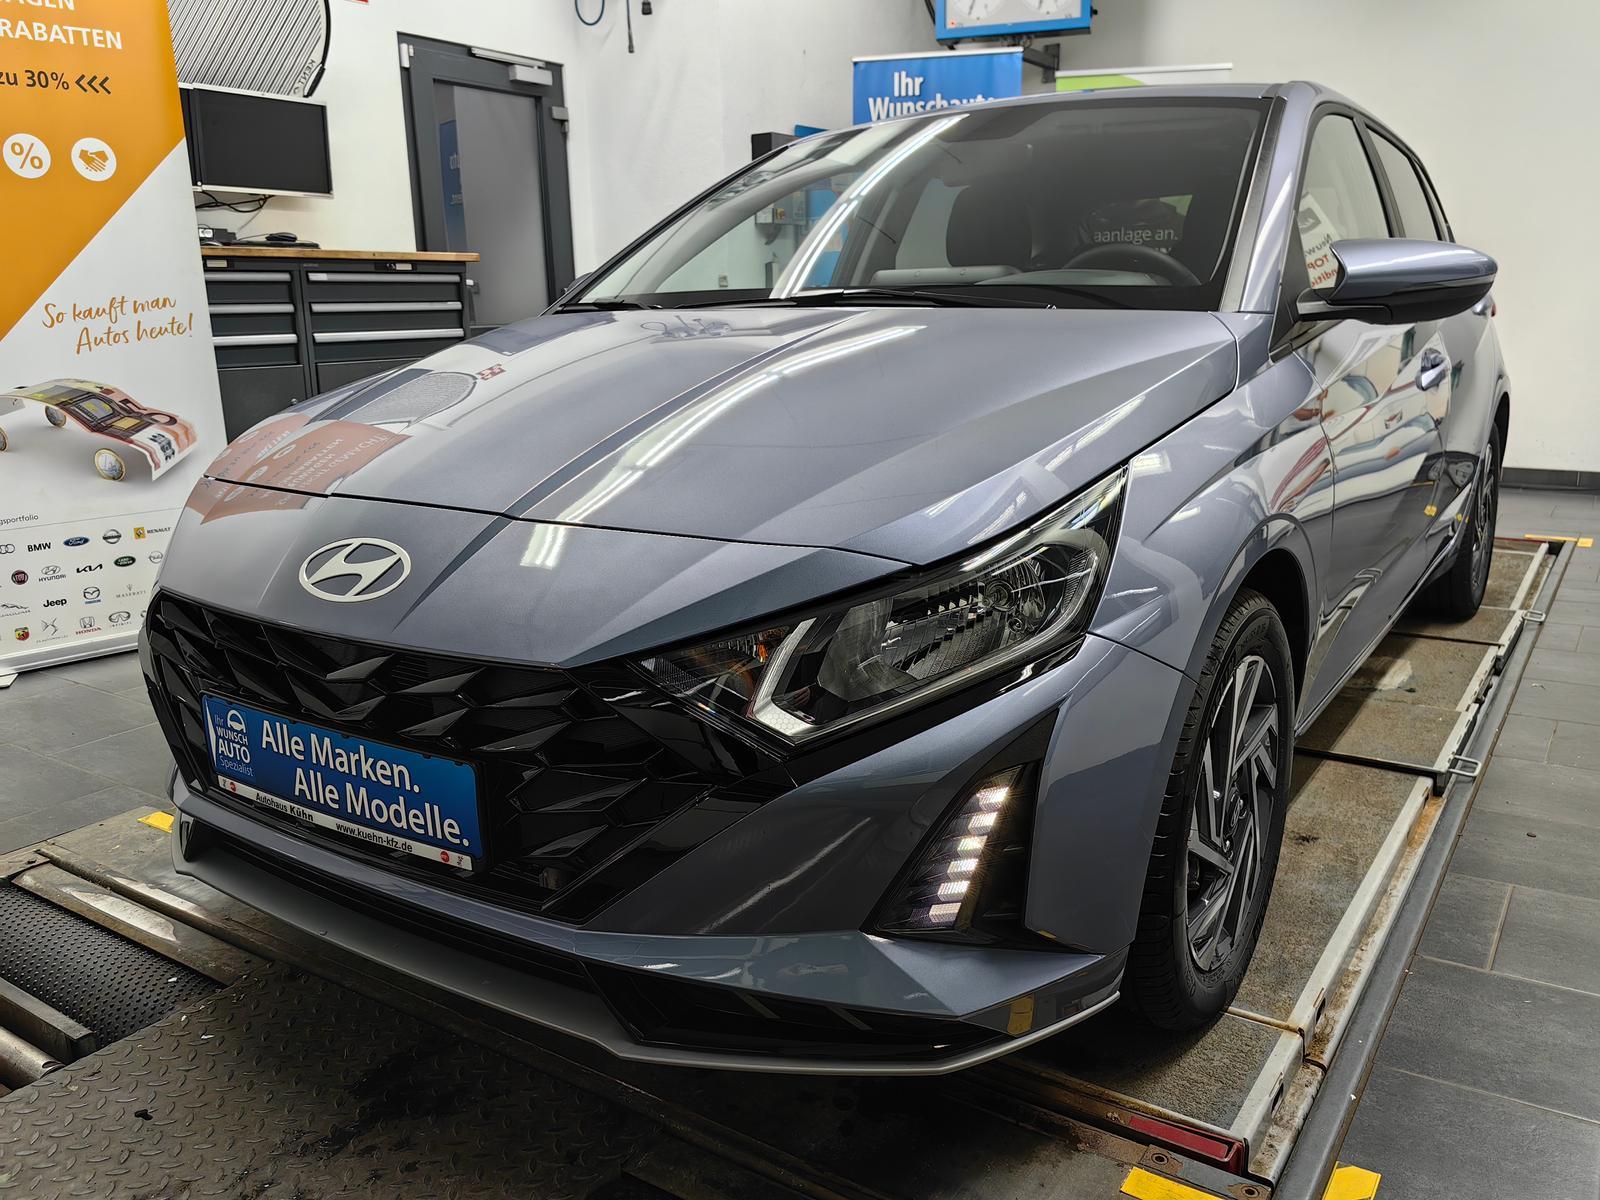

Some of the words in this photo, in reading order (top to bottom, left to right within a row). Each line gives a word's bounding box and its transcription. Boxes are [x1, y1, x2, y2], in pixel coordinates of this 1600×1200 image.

[0, 18, 123, 50] RABATTEN
[24, 69, 70, 91] 30%
[893, 70, 924, 97] Ihr
[868, 93, 995, 121] Wunsch
[42, 302, 67, 329] So
[72, 296, 127, 324] kauft
[132, 297, 177, 313] man
[75, 326, 130, 355] Autos
[136, 312, 194, 342] heute!
[27, 542, 51, 552] BMW
[38, 573, 67, 582] HYUNDAI
[43, 598, 67, 608] Jeep
[75, 627, 102, 635] HONDA
[214, 714, 224, 726] Ihr
[216, 726, 249, 746] WUNSCH
[218, 739, 251, 764] AUTO
[261, 719, 305, 760] Alle
[310, 733, 421, 794] Marken.
[219, 755, 254, 777] Spezialist
[294, 767, 340, 810] Alle
[346, 782, 471, 847] Modelle.
[255, 792, 289, 813] Autohaus
[289, 804, 314, 822] Kühn
[335, 821, 413, 853] www.kuehn-kfz.de
